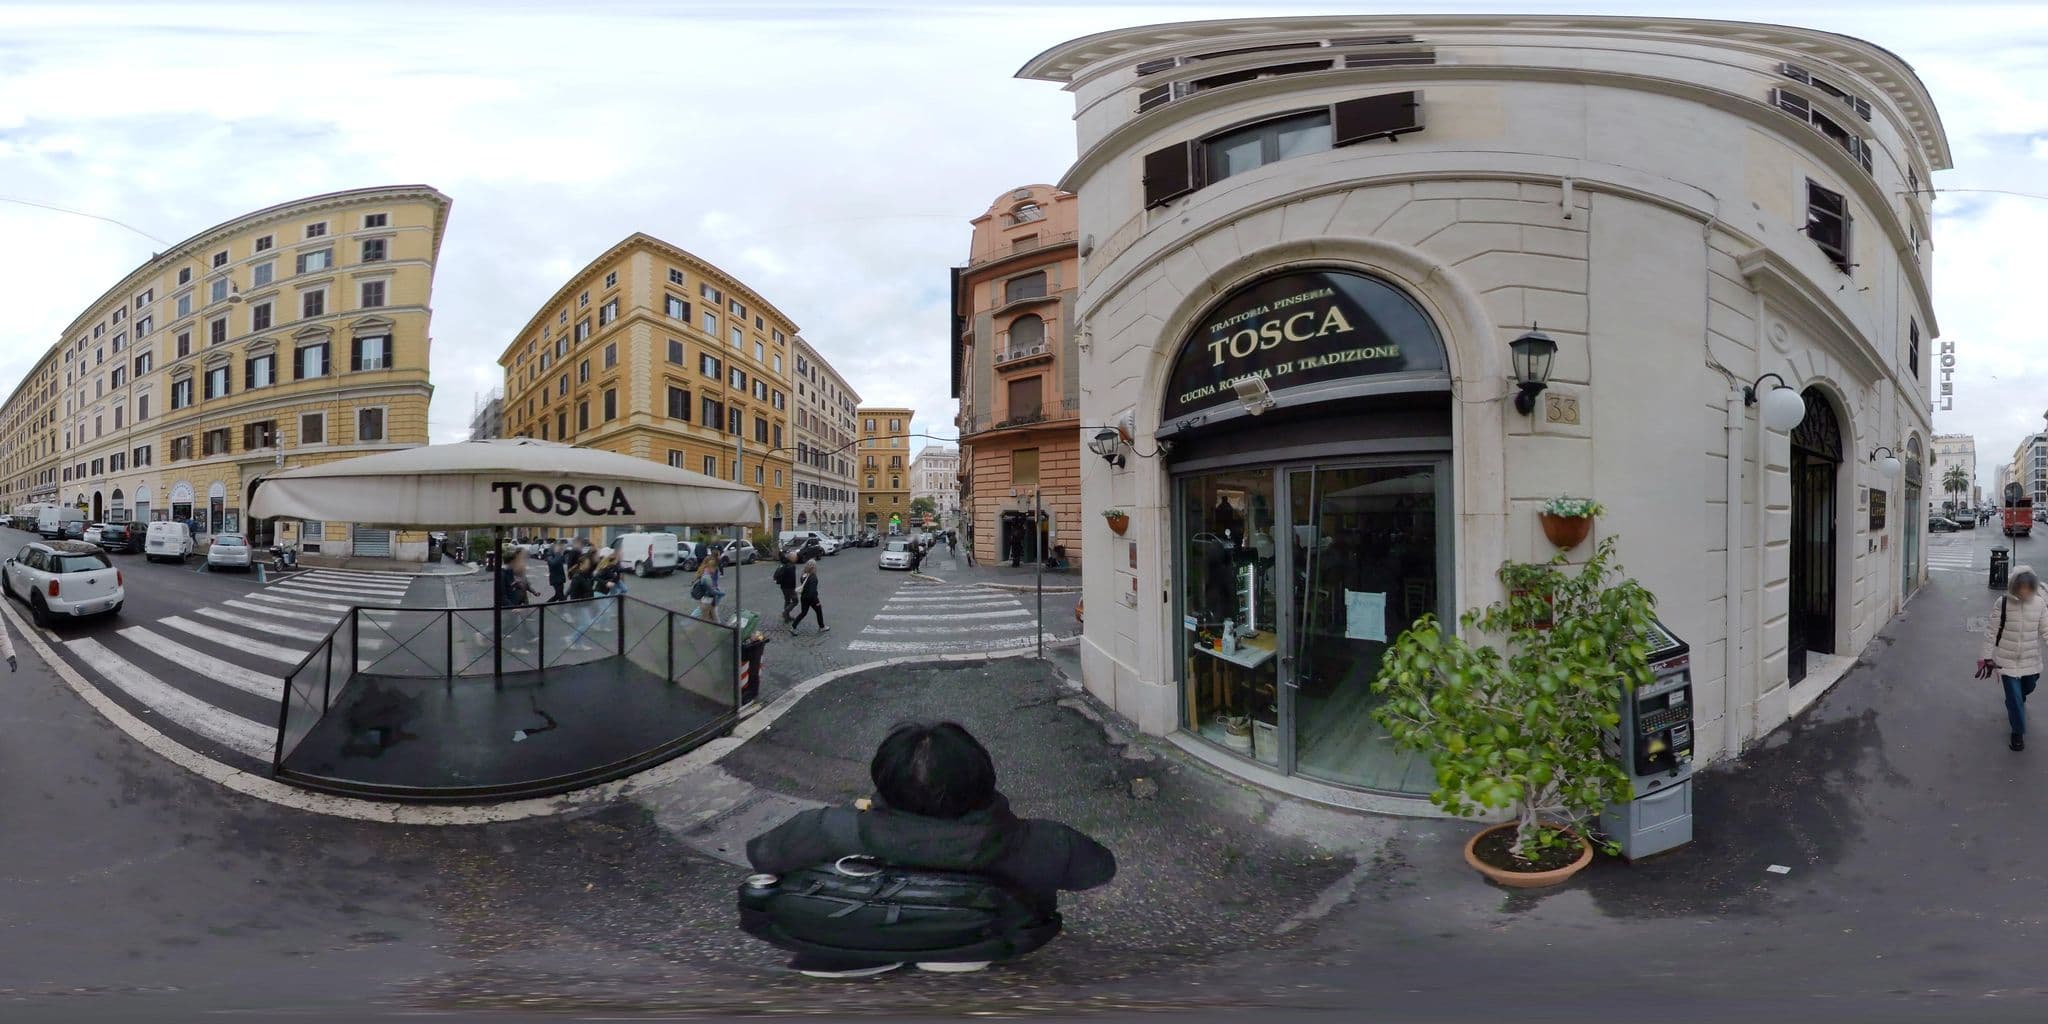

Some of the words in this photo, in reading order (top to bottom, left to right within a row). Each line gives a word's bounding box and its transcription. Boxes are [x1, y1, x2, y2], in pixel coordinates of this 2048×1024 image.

[1210, 305, 1270, 333] TRATTORIA
[1273, 287, 1335, 309] PINSERIA
[1208, 305, 1354, 367] TOSCA
[1180, 384, 1216, 404] CUCINA
[1277, 362, 1294, 376] DI
[1298, 344, 1400, 371] TRADIZIONE
[1549, 397, 1577, 421] 33
[491, 481, 636, 516] TOSCA
